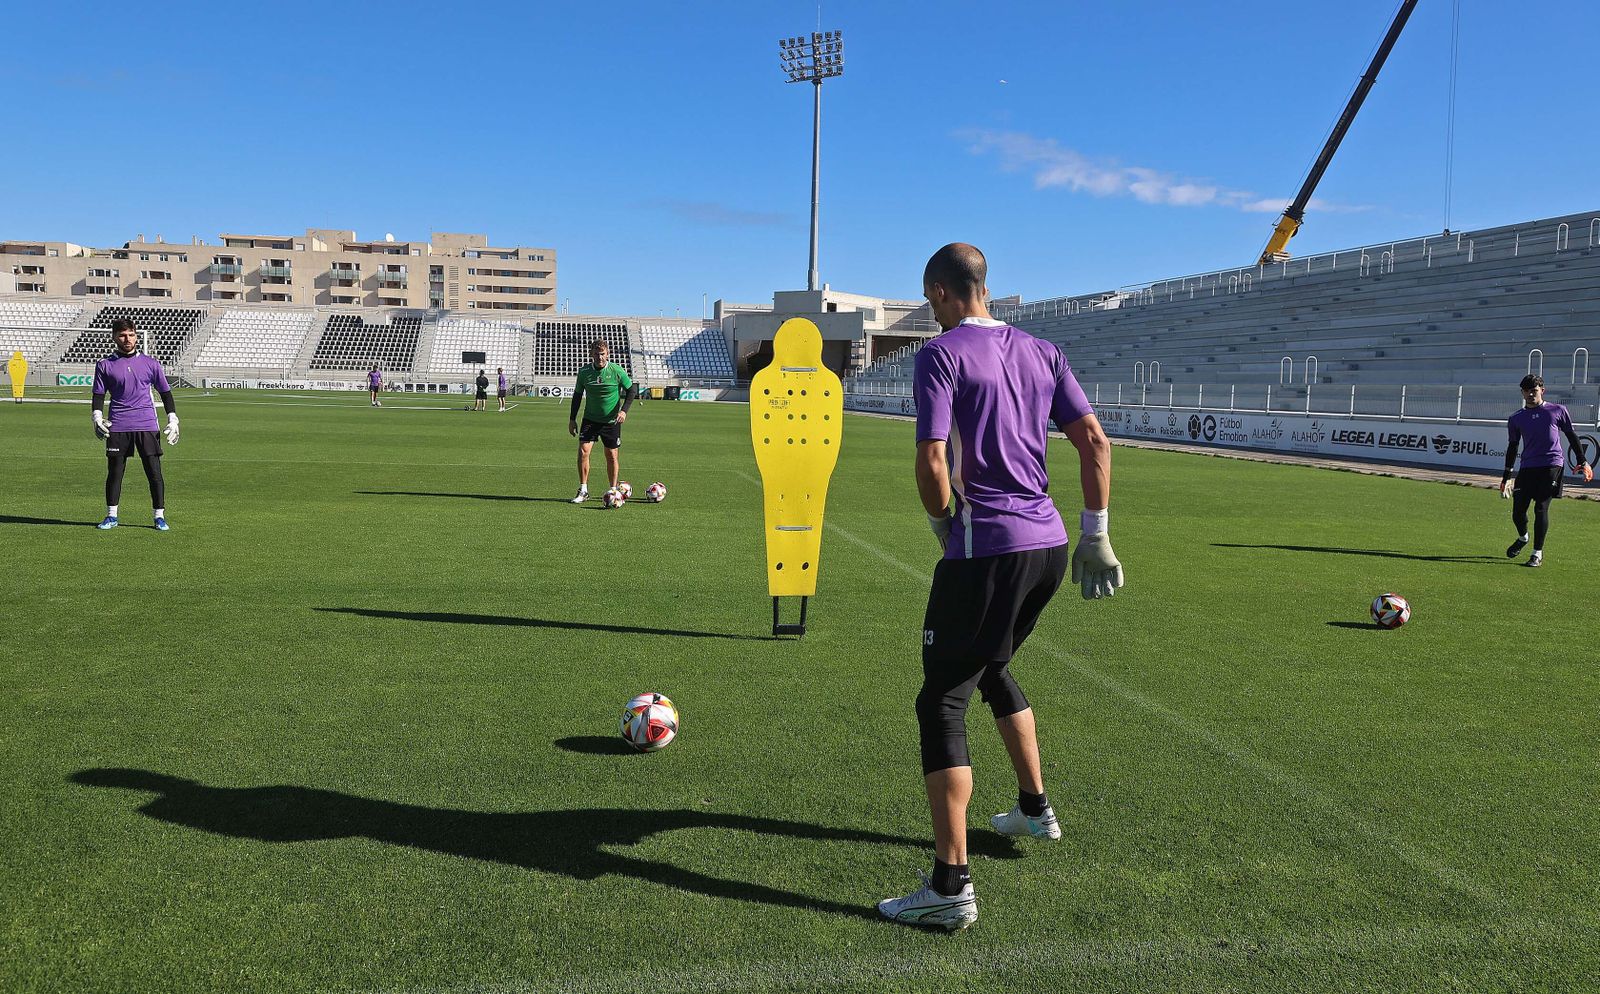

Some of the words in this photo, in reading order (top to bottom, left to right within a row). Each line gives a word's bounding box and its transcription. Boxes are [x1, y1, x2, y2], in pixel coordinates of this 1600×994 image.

[1219, 417, 1243, 429] Fútbol
[1219, 430, 1248, 443] Emotion
[1331, 429, 1375, 445] LEGEA
[1378, 432, 1428, 449] LEGEA
[923, 629, 934, 646] 13
